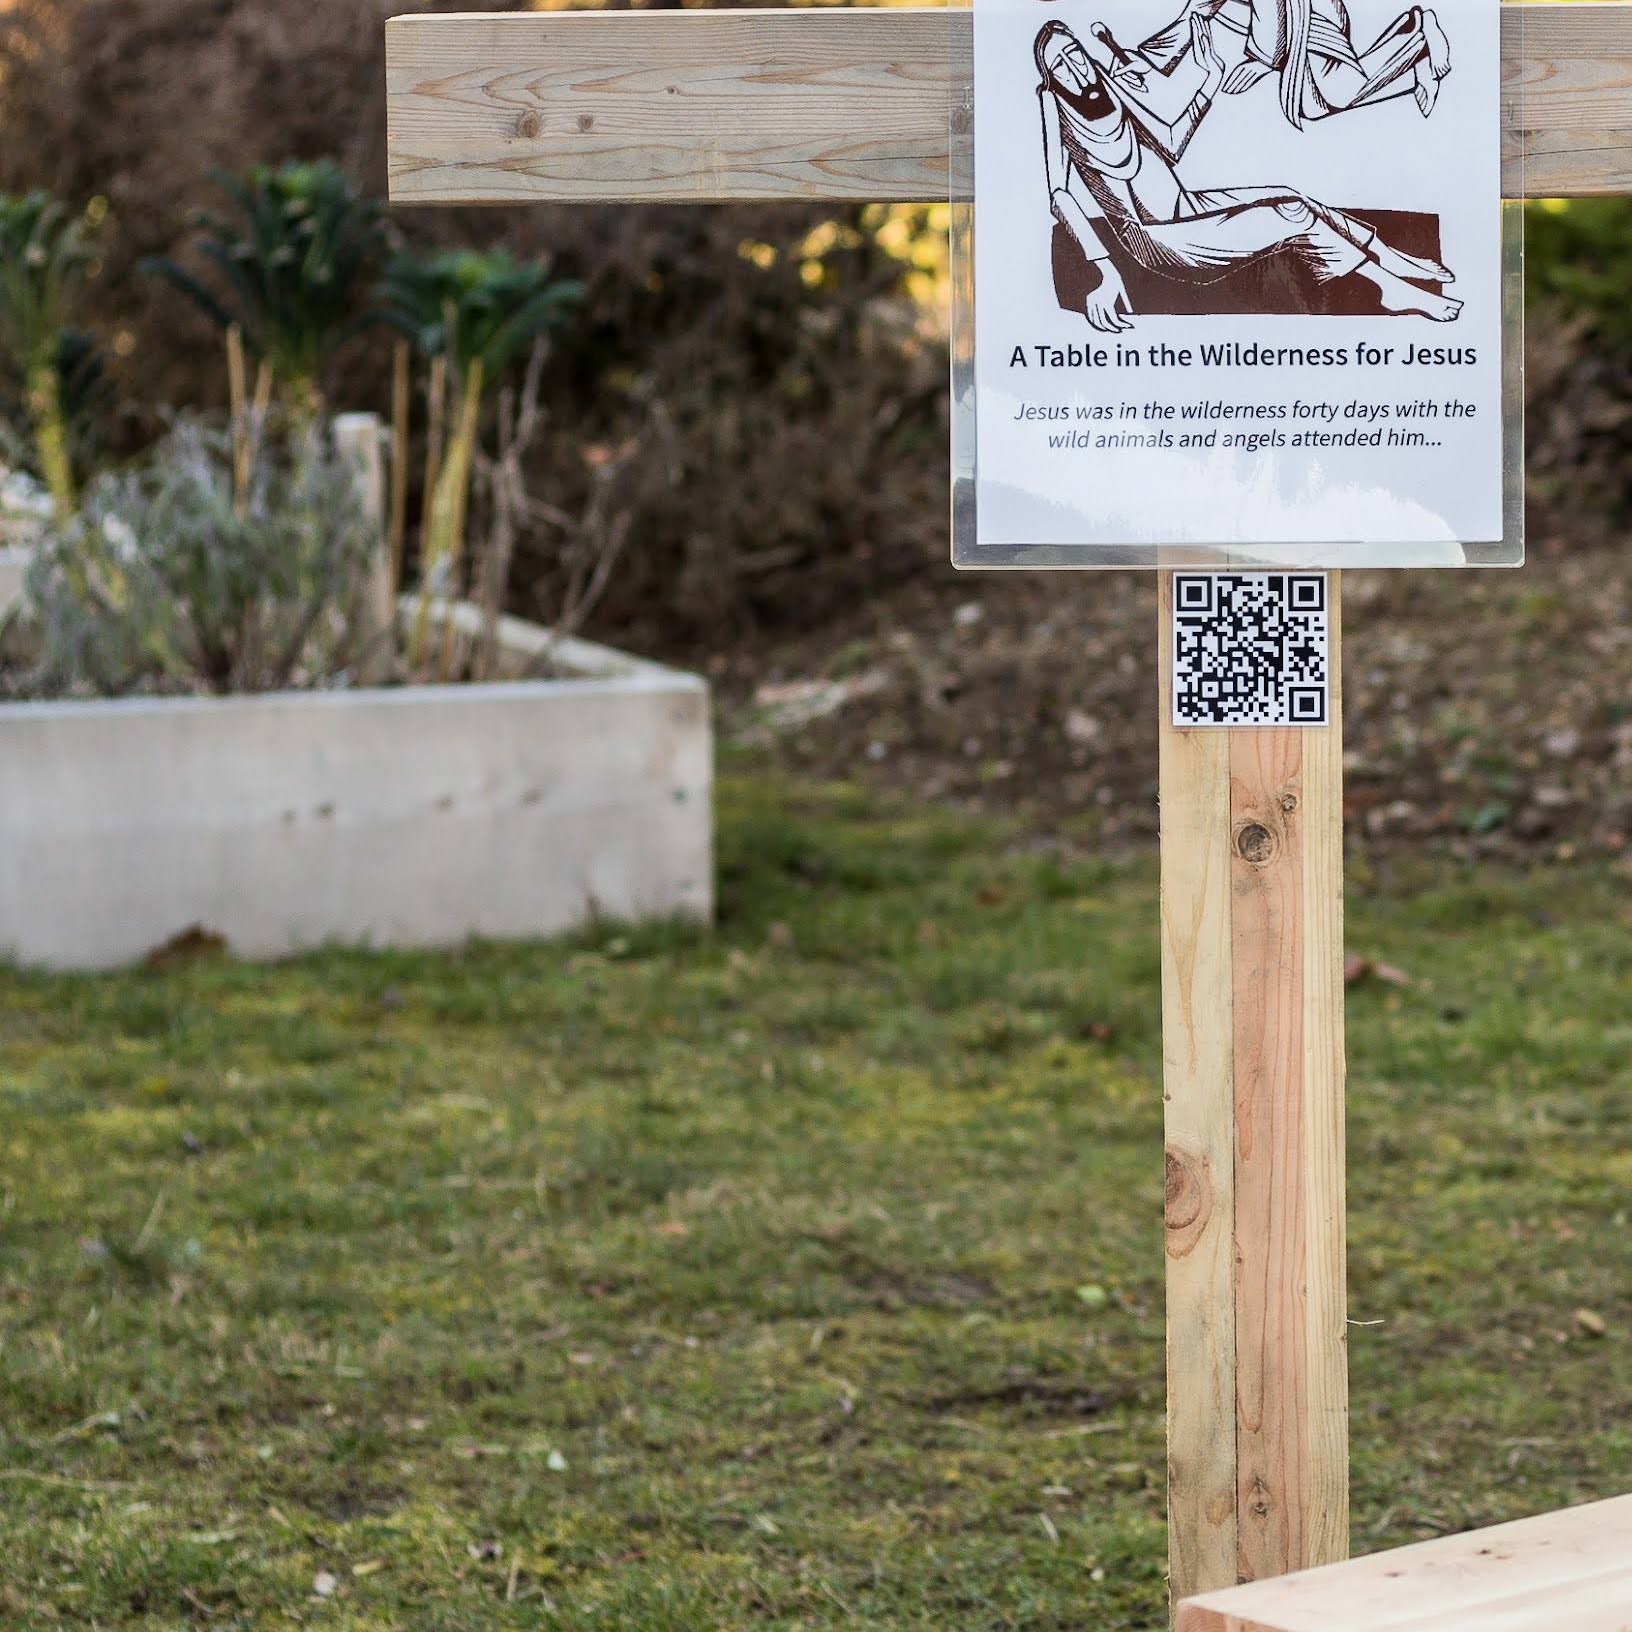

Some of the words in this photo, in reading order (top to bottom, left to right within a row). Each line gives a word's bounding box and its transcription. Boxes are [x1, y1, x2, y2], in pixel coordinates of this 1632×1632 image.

[1009, 345, 1028, 367] A
[1034, 343, 1108, 367] Table
[1116, 343, 1140, 367] in
[1148, 342, 1192, 366] the
[1200, 342, 1348, 366] Wilderness
[1356, 341, 1394, 366] for
[1401, 343, 1477, 366] Jesus
[1014, 403, 1069, 420] Jesus
[1076, 406, 1114, 419] was
[1119, 402, 1137, 419] in
[1143, 400, 1175, 419] the
[1181, 400, 1287, 419] wilderness
[1292, 400, 1339, 423] forty
[1344, 399, 1390, 423] days
[1396, 399, 1438, 418] with
[1444, 399, 1476, 418] the
[1048, 430, 1090, 448] wild
[1095, 429, 1174, 448] animals
[1179, 429, 1217, 447] and
[1222, 428, 1286, 452] angels
[1291, 428, 1382, 447] attended
[1387, 428, 1442, 447] him...
